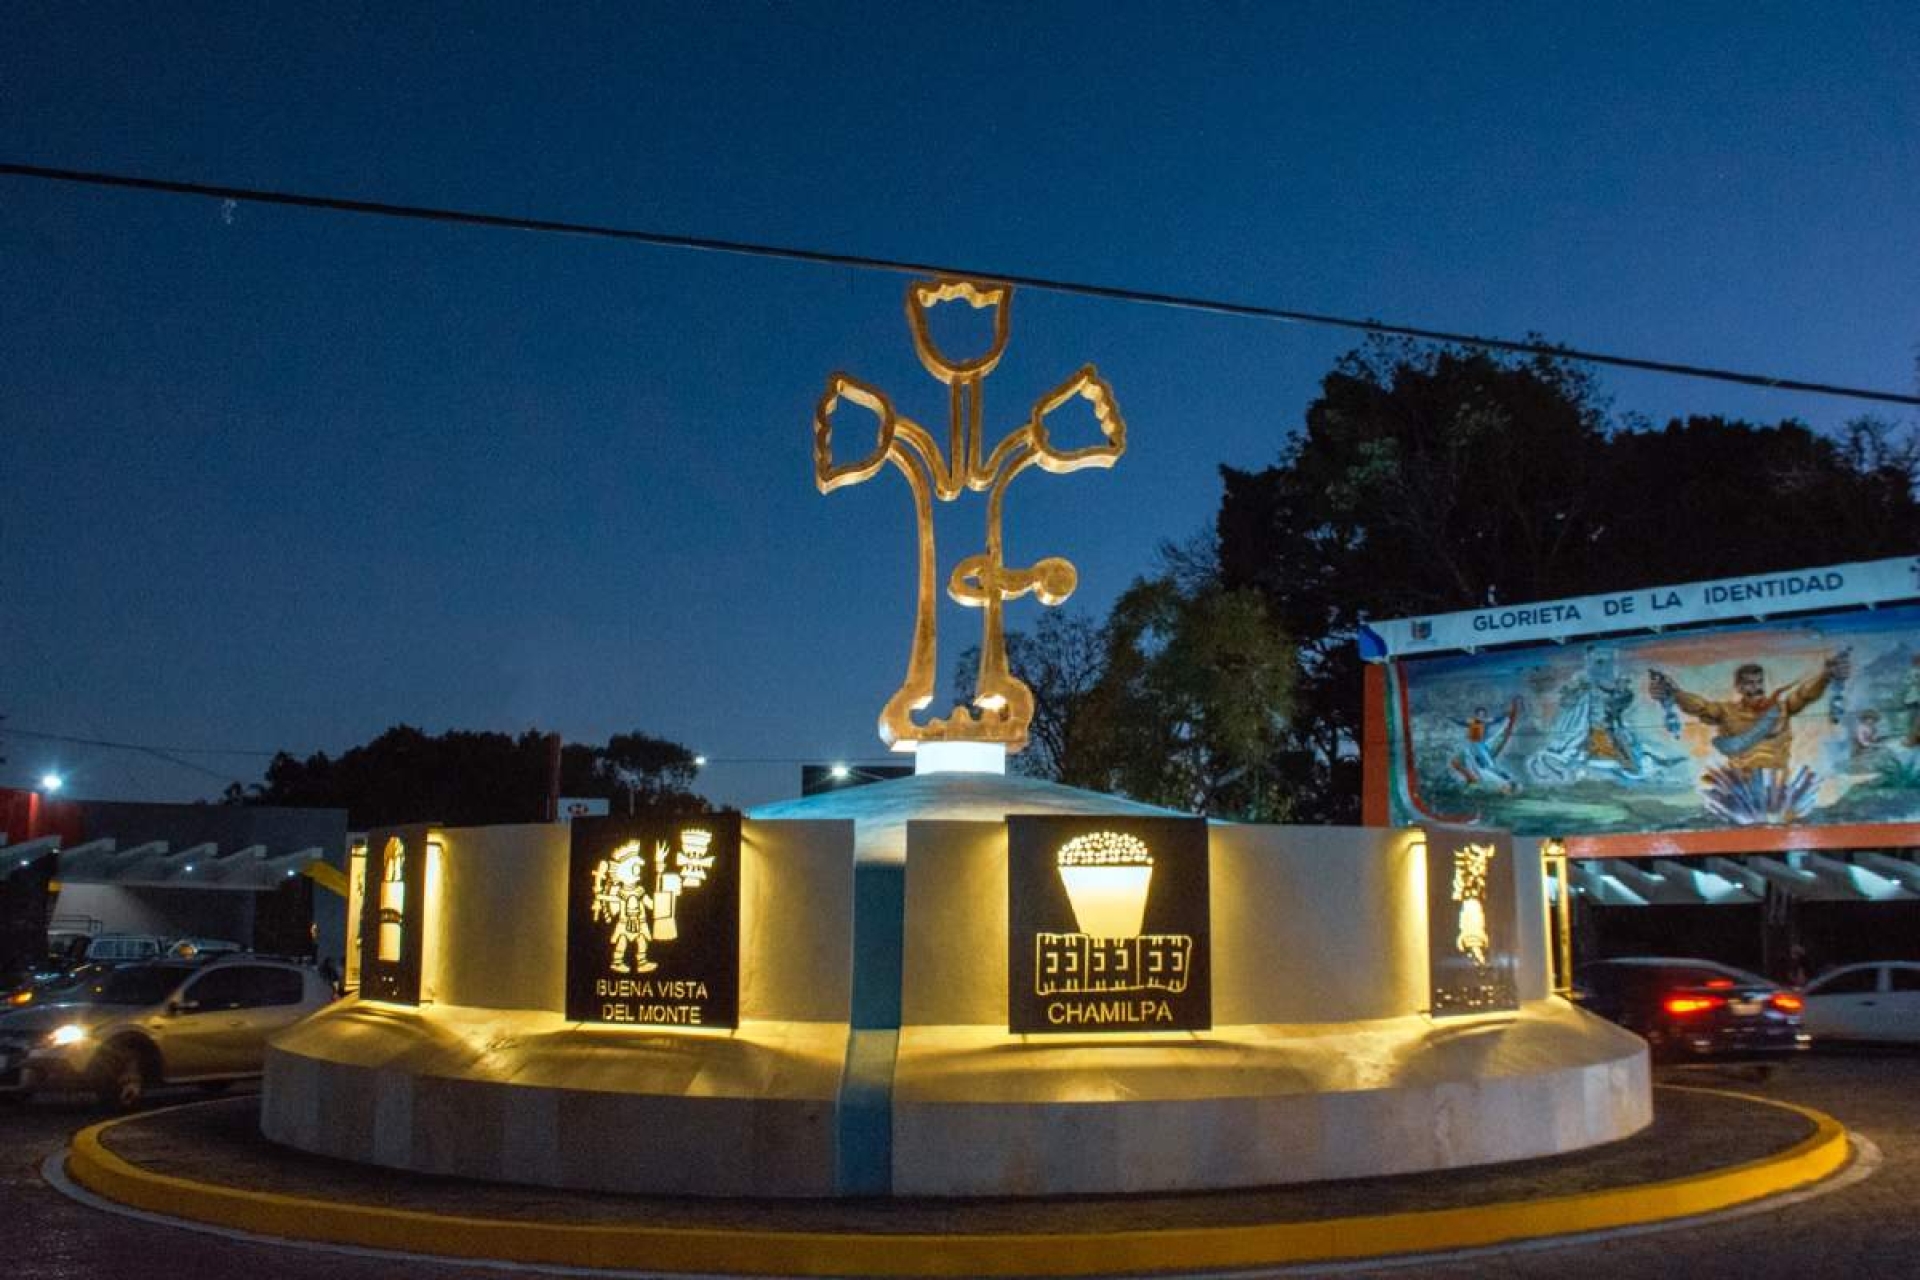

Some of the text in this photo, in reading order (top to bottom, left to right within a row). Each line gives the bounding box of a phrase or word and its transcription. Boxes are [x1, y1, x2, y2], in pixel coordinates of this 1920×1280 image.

[1473, 572, 1844, 631] GLORIETA DE LA IDENTIDAD
[596, 978, 708, 999] BUENA VISTA
[602, 1003, 702, 1024] DEL MONTE
[1047, 1000, 1173, 1024] CHAMILPA
